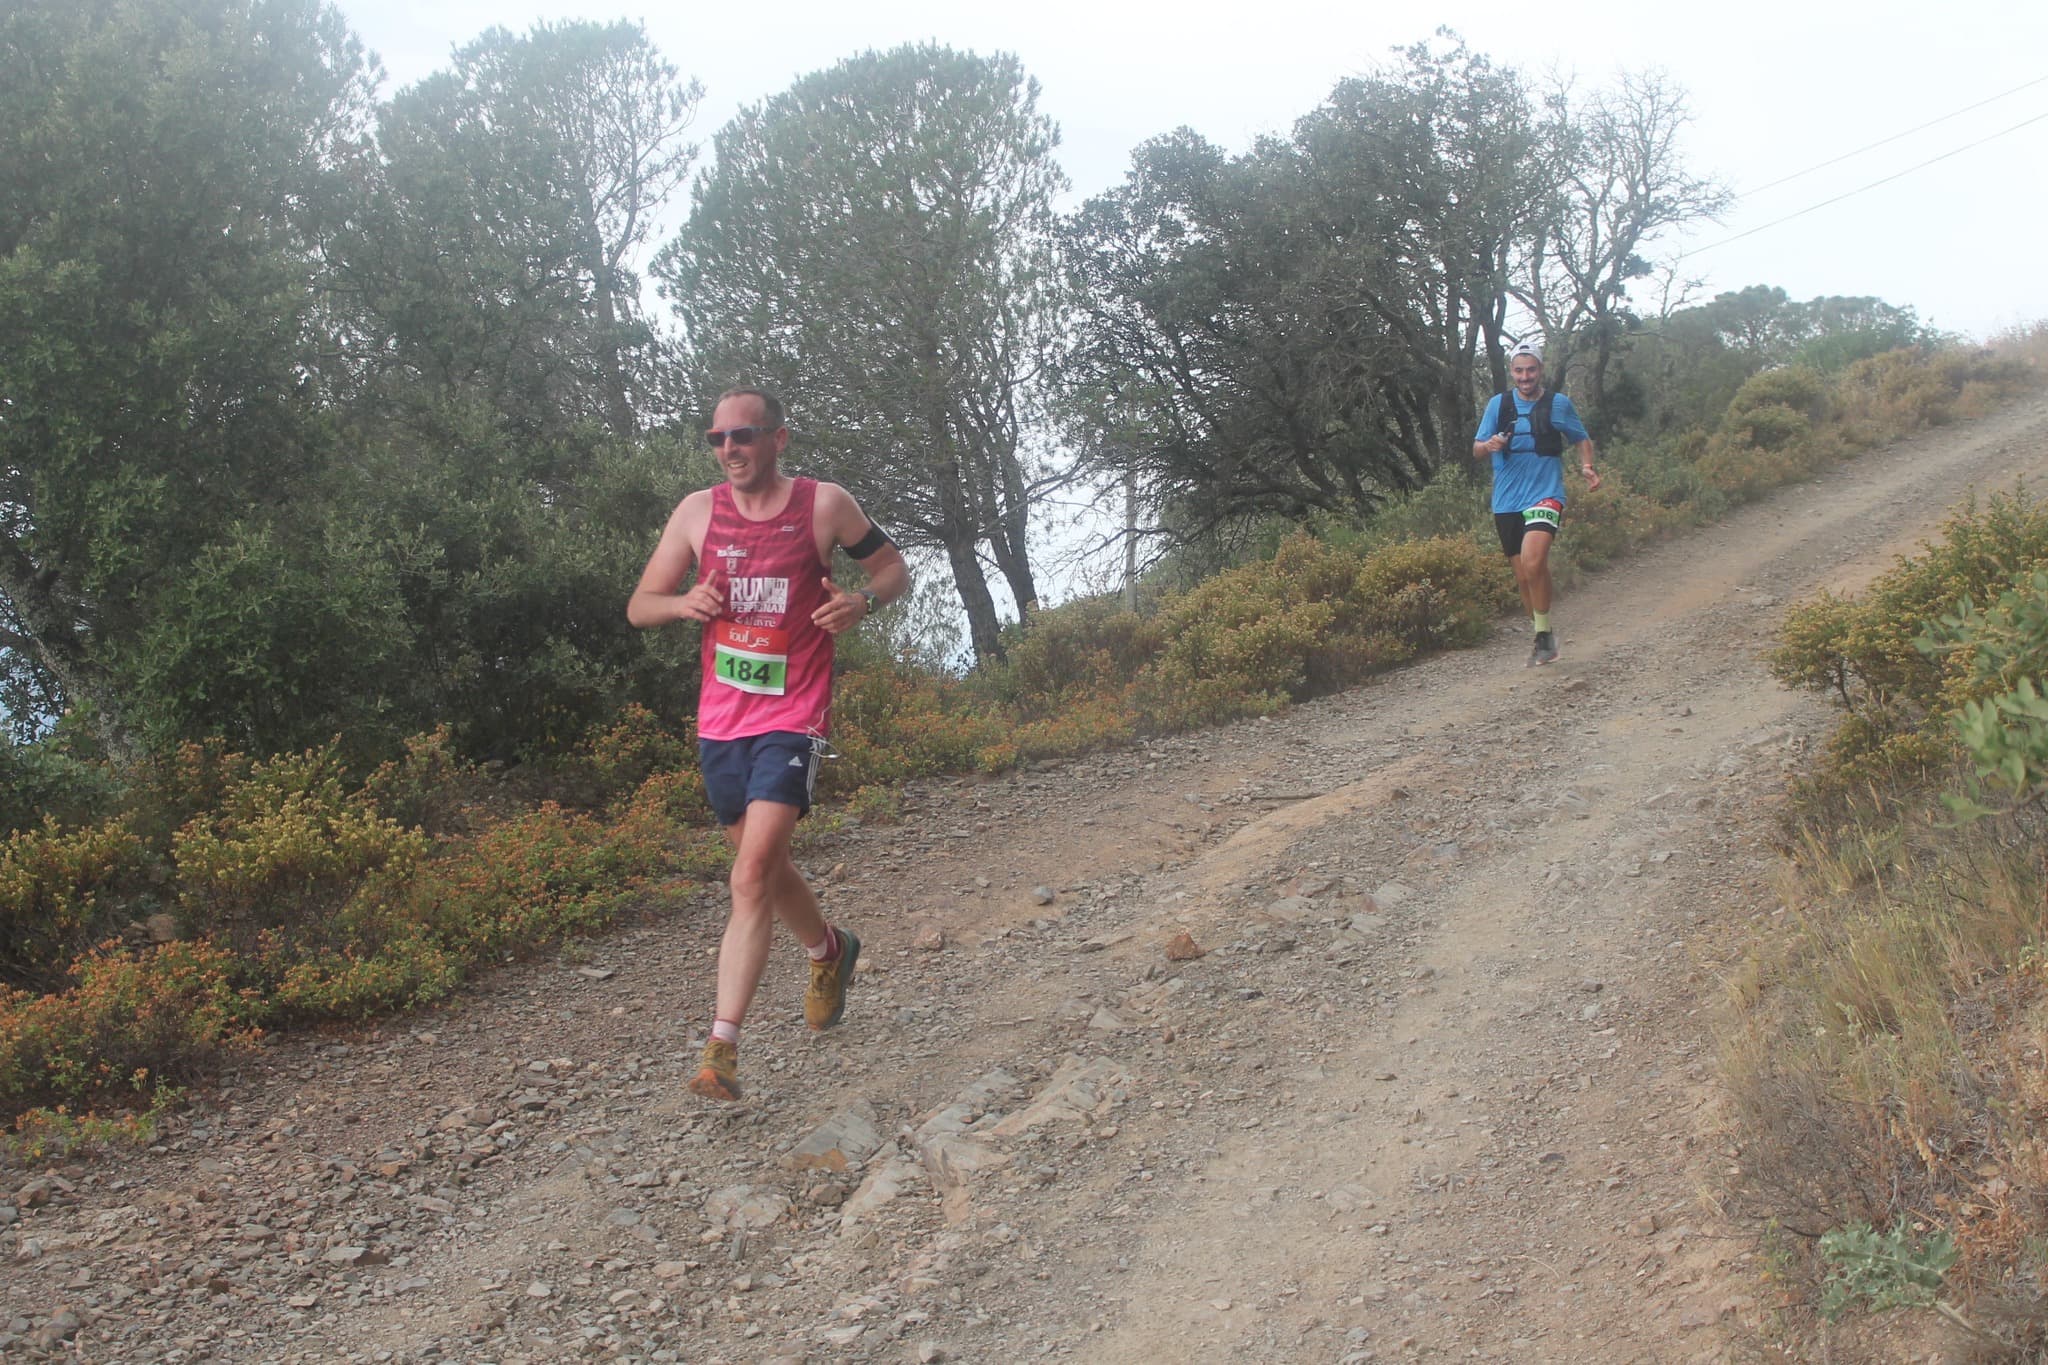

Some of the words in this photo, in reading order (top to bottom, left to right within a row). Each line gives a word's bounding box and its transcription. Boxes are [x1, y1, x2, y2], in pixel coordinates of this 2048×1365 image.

[1529, 510, 1553, 520] 106
[730, 577, 773, 602] RUN
[726, 657, 771, 685] 184
